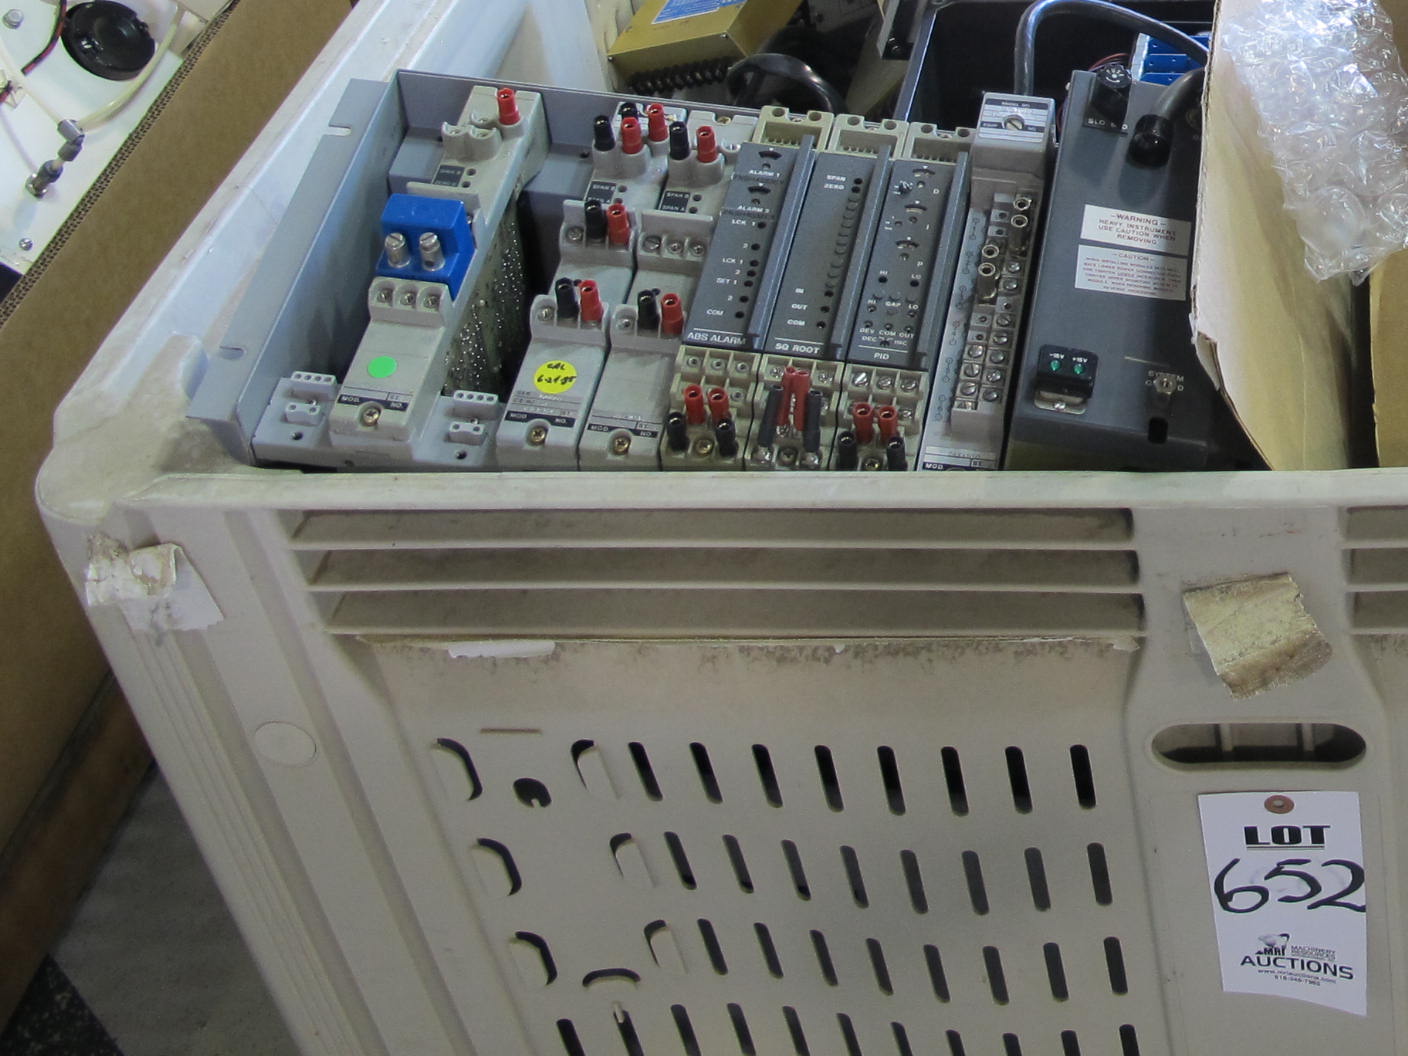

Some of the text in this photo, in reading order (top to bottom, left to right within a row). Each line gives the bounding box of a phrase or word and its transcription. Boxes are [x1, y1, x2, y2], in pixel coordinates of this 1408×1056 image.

[749, 169, 775, 177] ALARM
[827, 174, 847, 182] SPAN
[737, 205, 764, 213] ALARM
[1116, 213, 1158, 226] WARNING
[1116, 226, 1150, 237] CAUTION
[1117, 234, 1157, 245] REMOVING
[792, 303, 808, 311] OUT
[687, 332, 747, 345] ABS ALARM
[879, 329, 896, 337] COM
[775, 343, 820, 354] SQ ROOT
[874, 352, 890, 360] PID
[1244, 825, 1331, 845] LOT
[1213, 858, 1366, 913] 652
[1240, 955, 1354, 980] AUCTIONS
